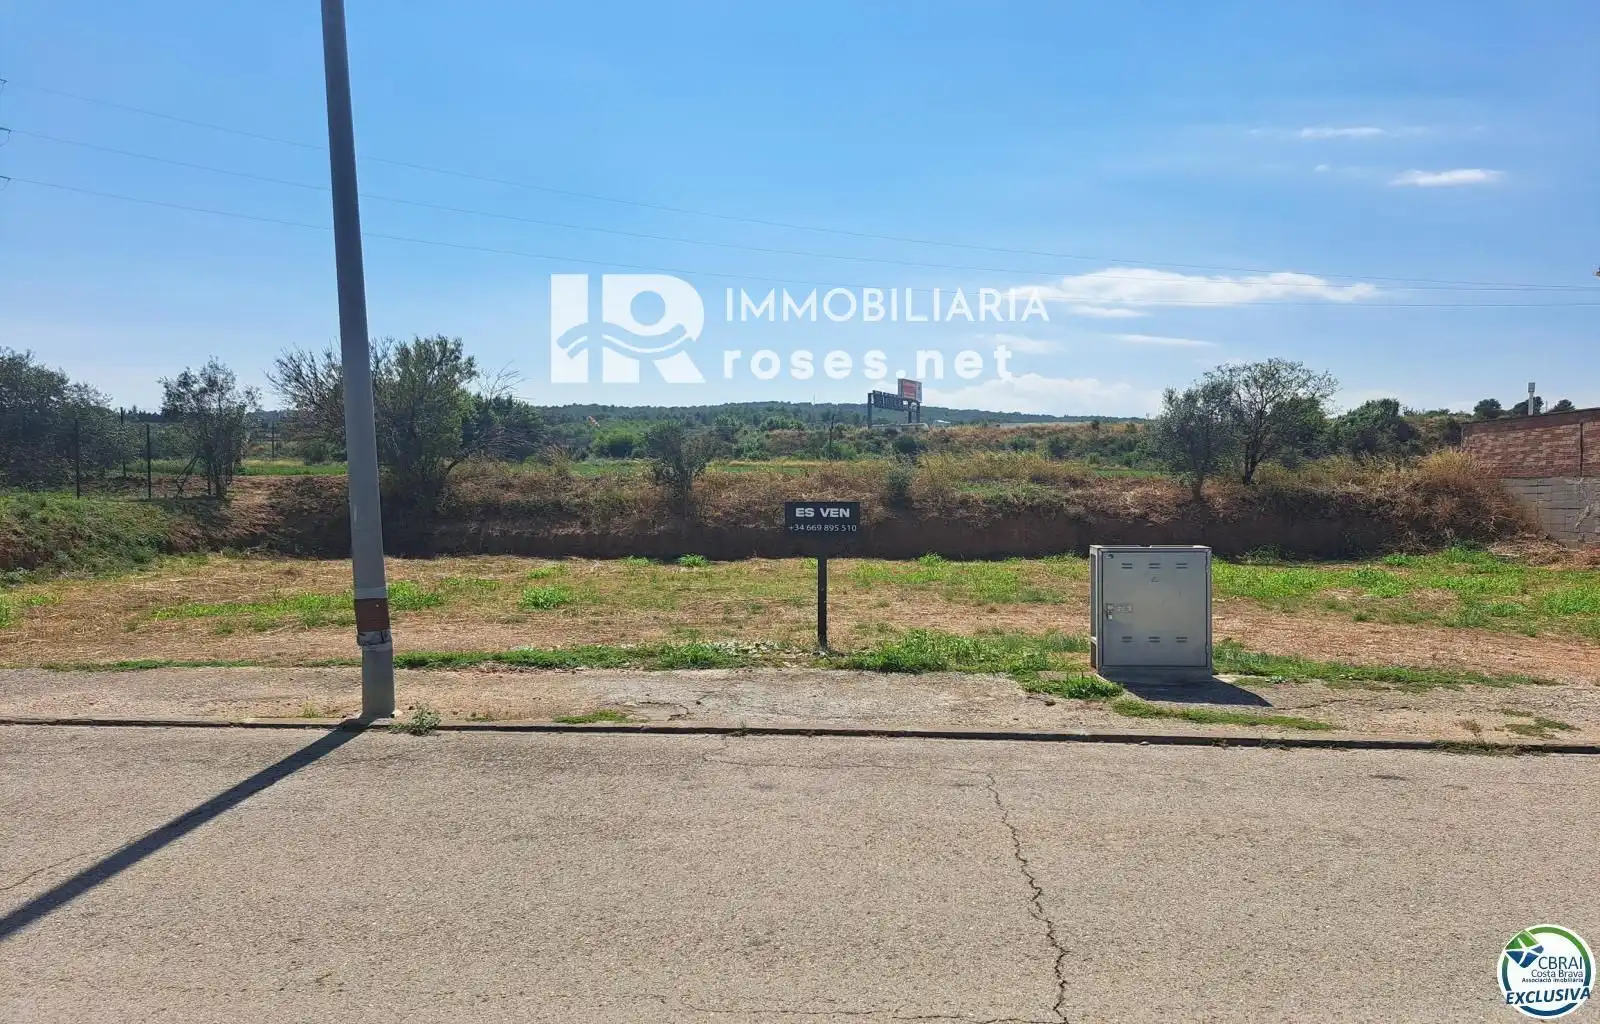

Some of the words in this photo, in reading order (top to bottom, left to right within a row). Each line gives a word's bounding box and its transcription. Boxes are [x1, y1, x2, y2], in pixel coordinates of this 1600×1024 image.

[795, 507, 815, 518] ES
[820, 507, 850, 518] VEN
[788, 523, 804, 532] +34
[806, 523, 822, 532] 669
[823, 523, 839, 532] 895
[841, 523, 857, 532] 510
